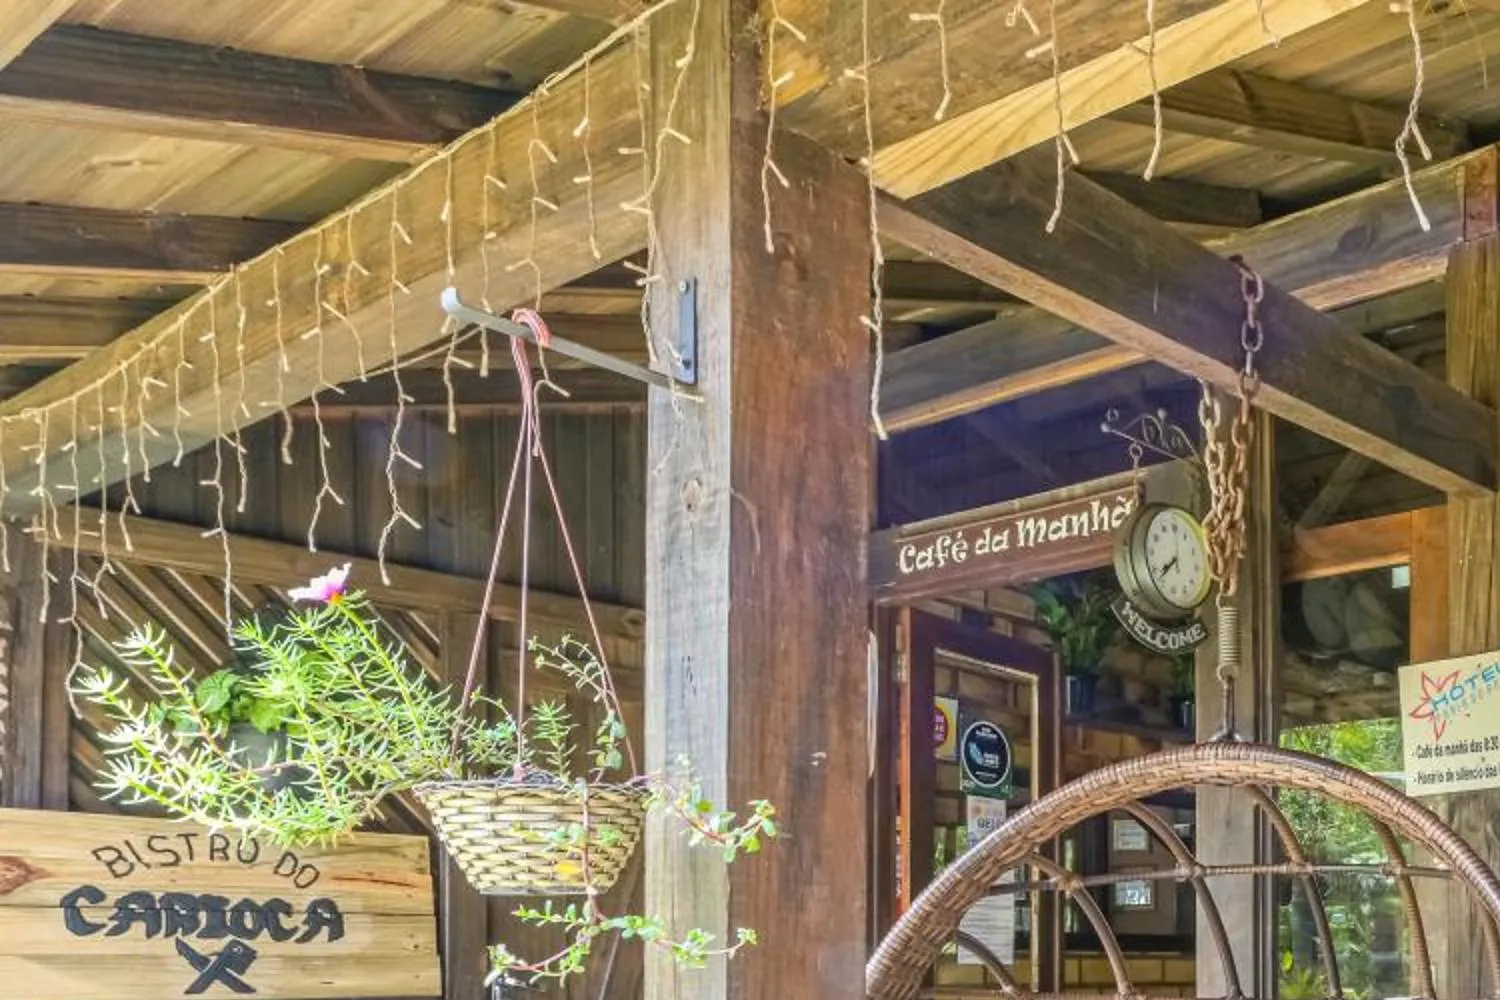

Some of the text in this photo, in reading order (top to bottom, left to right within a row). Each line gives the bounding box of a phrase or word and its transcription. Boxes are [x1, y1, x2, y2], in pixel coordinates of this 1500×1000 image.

[900, 496, 1134, 574] Café da Manhã
[1122, 601, 1206, 649] WELCOME
[273, 851, 320, 889] DO
[60, 884, 346, 944] CARIOCA
